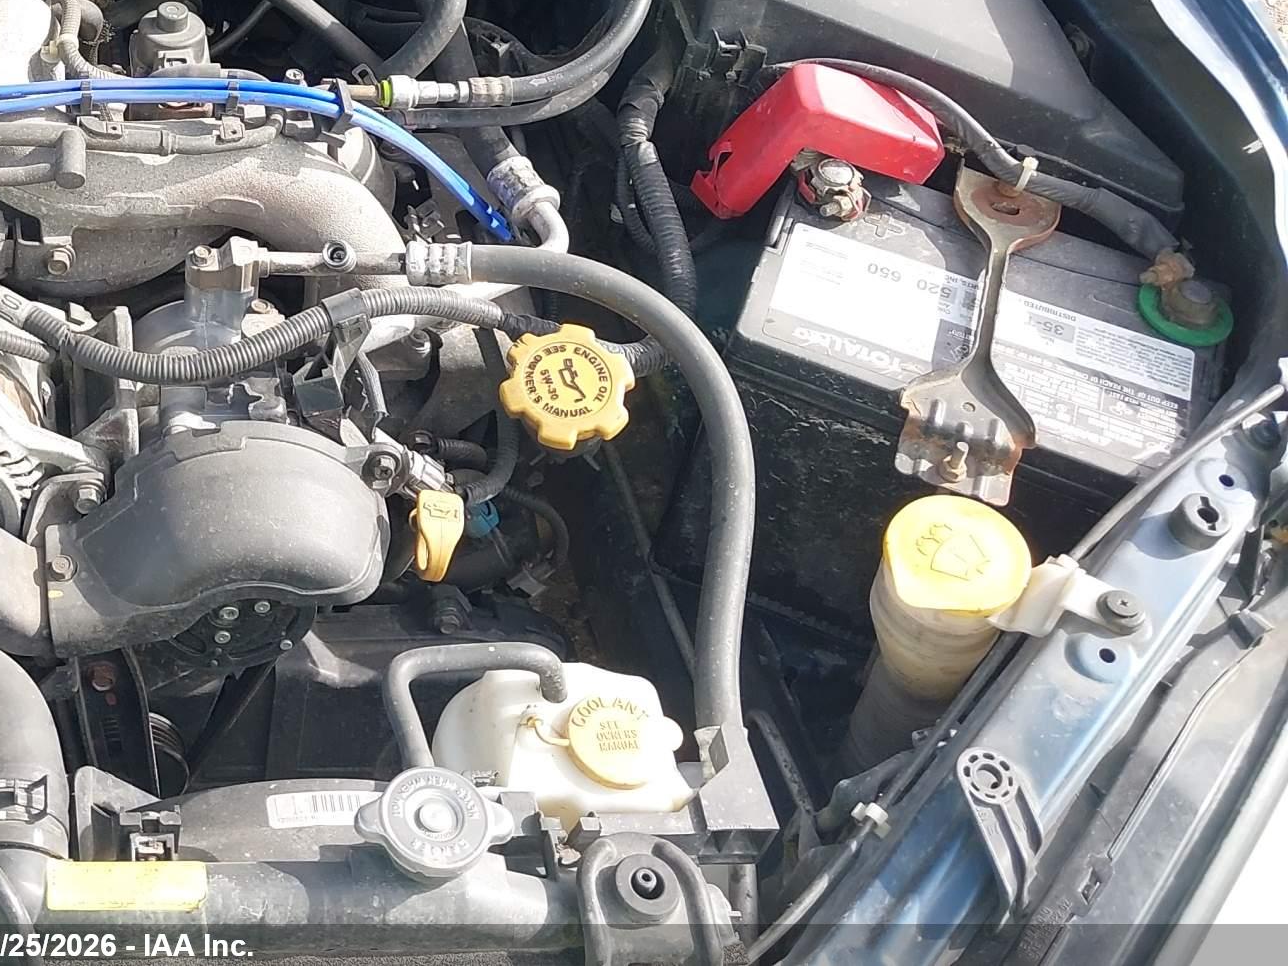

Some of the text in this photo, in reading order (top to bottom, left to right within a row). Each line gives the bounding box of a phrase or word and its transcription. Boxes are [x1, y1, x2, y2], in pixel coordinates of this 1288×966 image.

[867, 262, 951, 298] 520 650
[1023, 300, 1076, 322] DISTRIBUTED
[543, 344, 608, 403] SEE ENGINE OIL
[540, 369, 559, 400] 5W-30
[1136, 390, 1146, 398] OF
[1146, 393, 1161, 403] OUT
[1161, 399, 1178, 409] KEEP
[543, 403, 592, 418] MANUAL
[571, 697, 649, 727] COOLANT
[600, 721, 619, 730] SEE
[409, 838, 470, 858] DANGER
